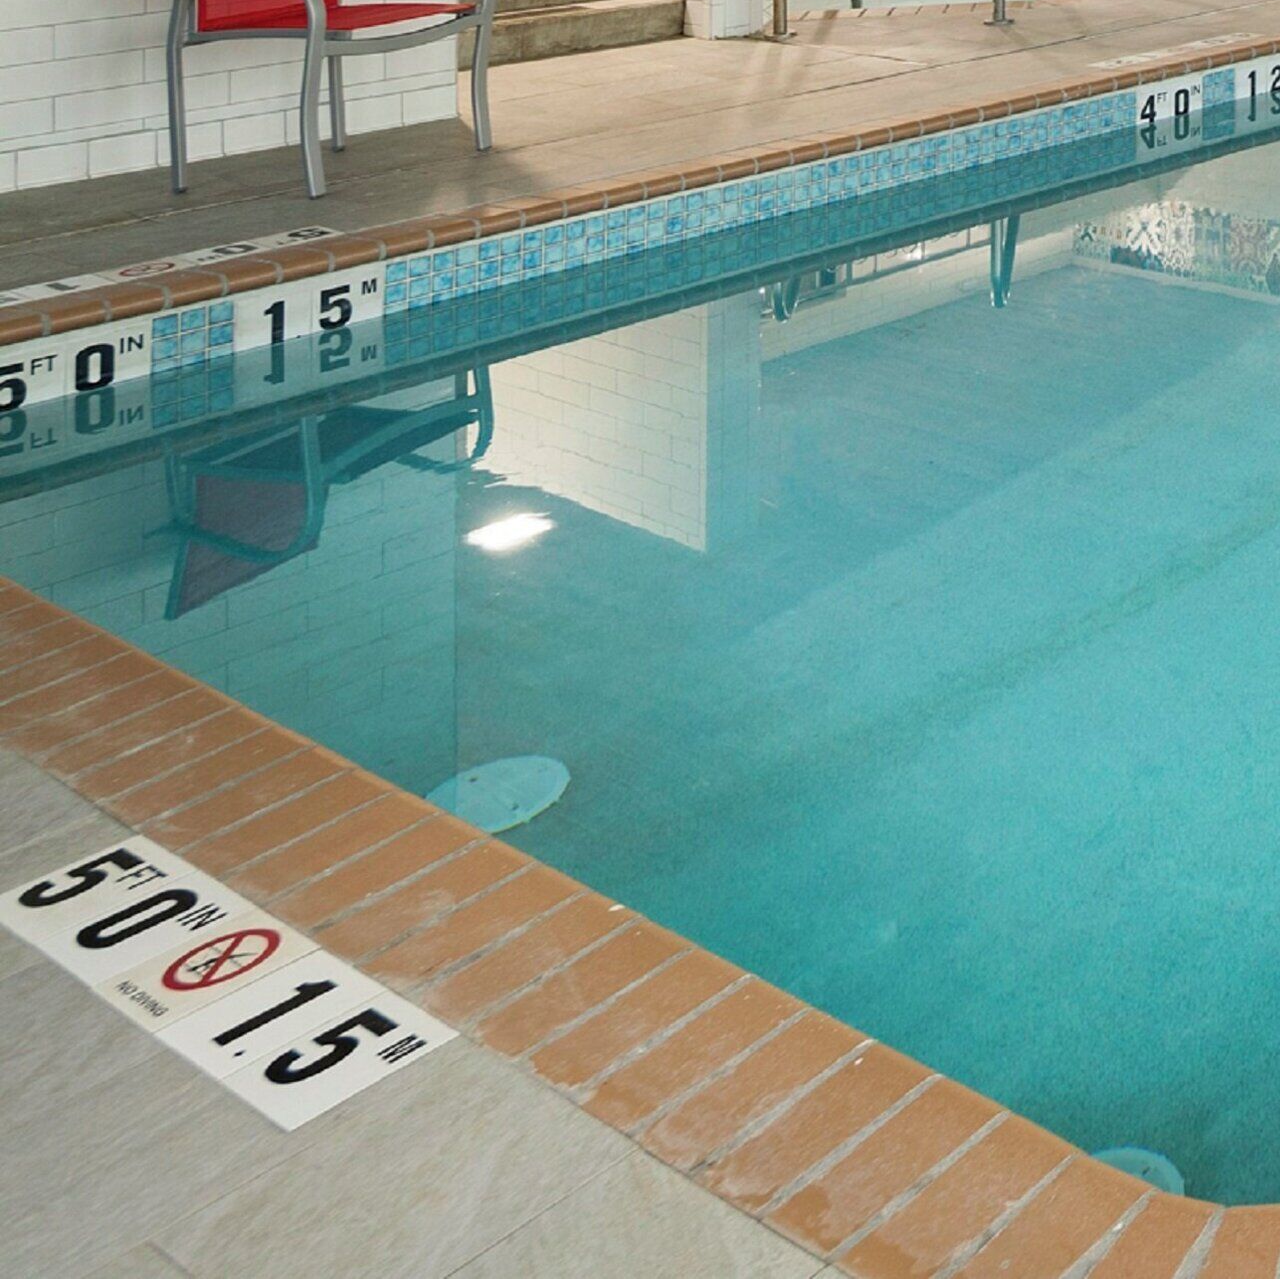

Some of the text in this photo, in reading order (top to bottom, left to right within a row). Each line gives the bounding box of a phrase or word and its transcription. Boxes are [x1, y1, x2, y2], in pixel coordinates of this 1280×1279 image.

[1141, 95, 1157, 123] 4
[1157, 92, 1168, 103] FT
[1175, 89, 1189, 116] 0
[361, 278, 377, 295] M
[31, 354, 58, 376] FT
[75, 343, 115, 392] 0
[120, 334, 143, 354] IN
[18, 846, 229, 950] 5 FT 0 IN
[115, 980, 170, 1017] NO DIVING
[376, 1034, 428, 1064] M
